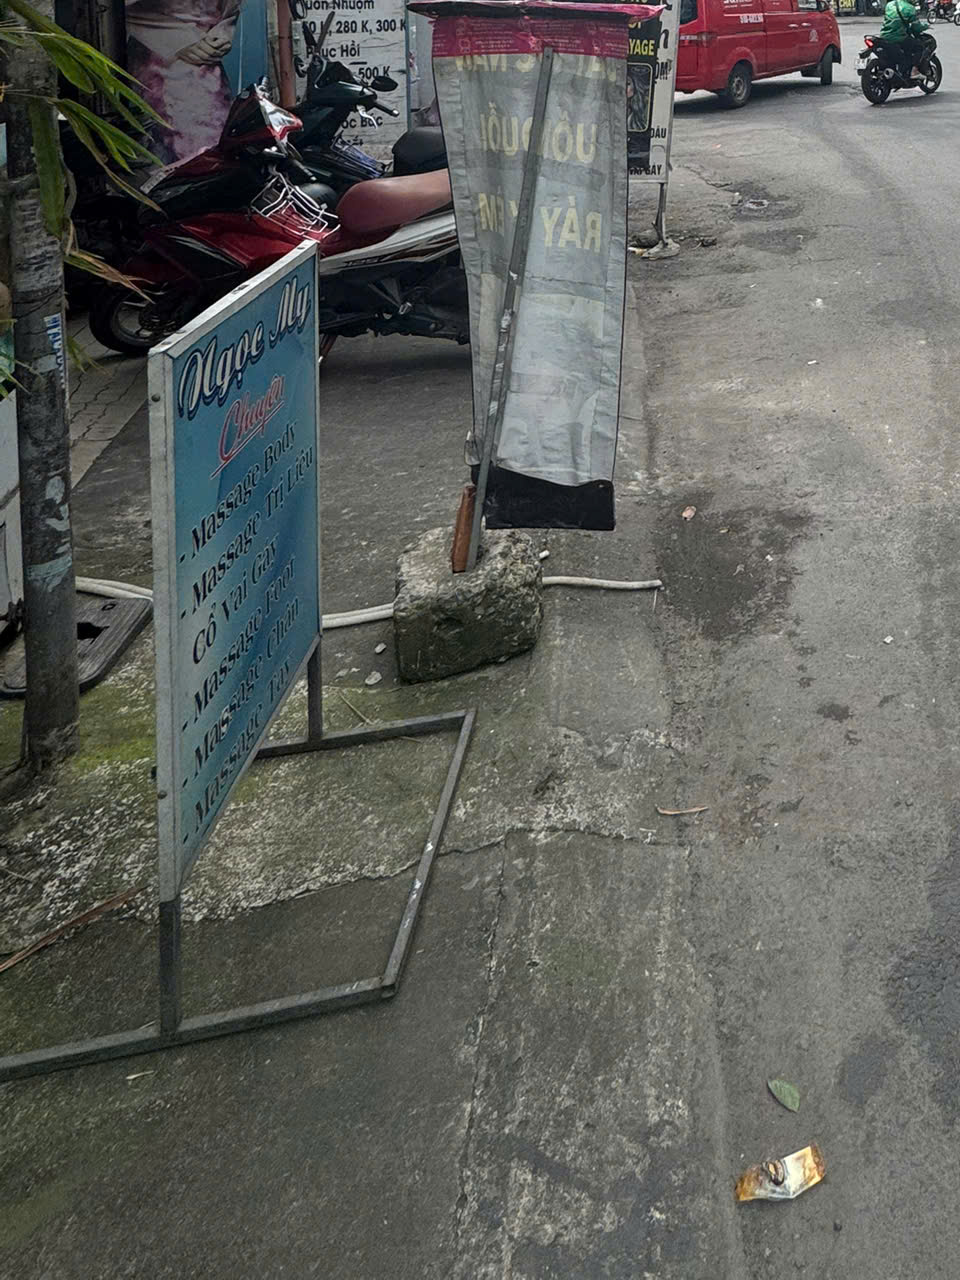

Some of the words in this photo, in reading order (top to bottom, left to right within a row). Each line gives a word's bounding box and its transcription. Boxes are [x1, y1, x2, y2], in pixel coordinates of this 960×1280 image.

[336, 20, 357, 33] 280
[376, 19, 396, 32] 300
[179, 321, 264, 419] Ngọc
[191, 463, 260, 560] Massage
[263, 421, 296, 477] Body
[192, 511, 261, 615] Massage
[192, 603, 217, 665] Cổ
[220, 571, 247, 623] Vai
[193, 609, 262, 725] Massage
[265, 555, 295, 618] Foot
[193, 655, 262, 778] Massage
[266, 595, 299, 660] Chân
[194, 703, 263, 834] Massage
[266, 657, 292, 698] Tay
